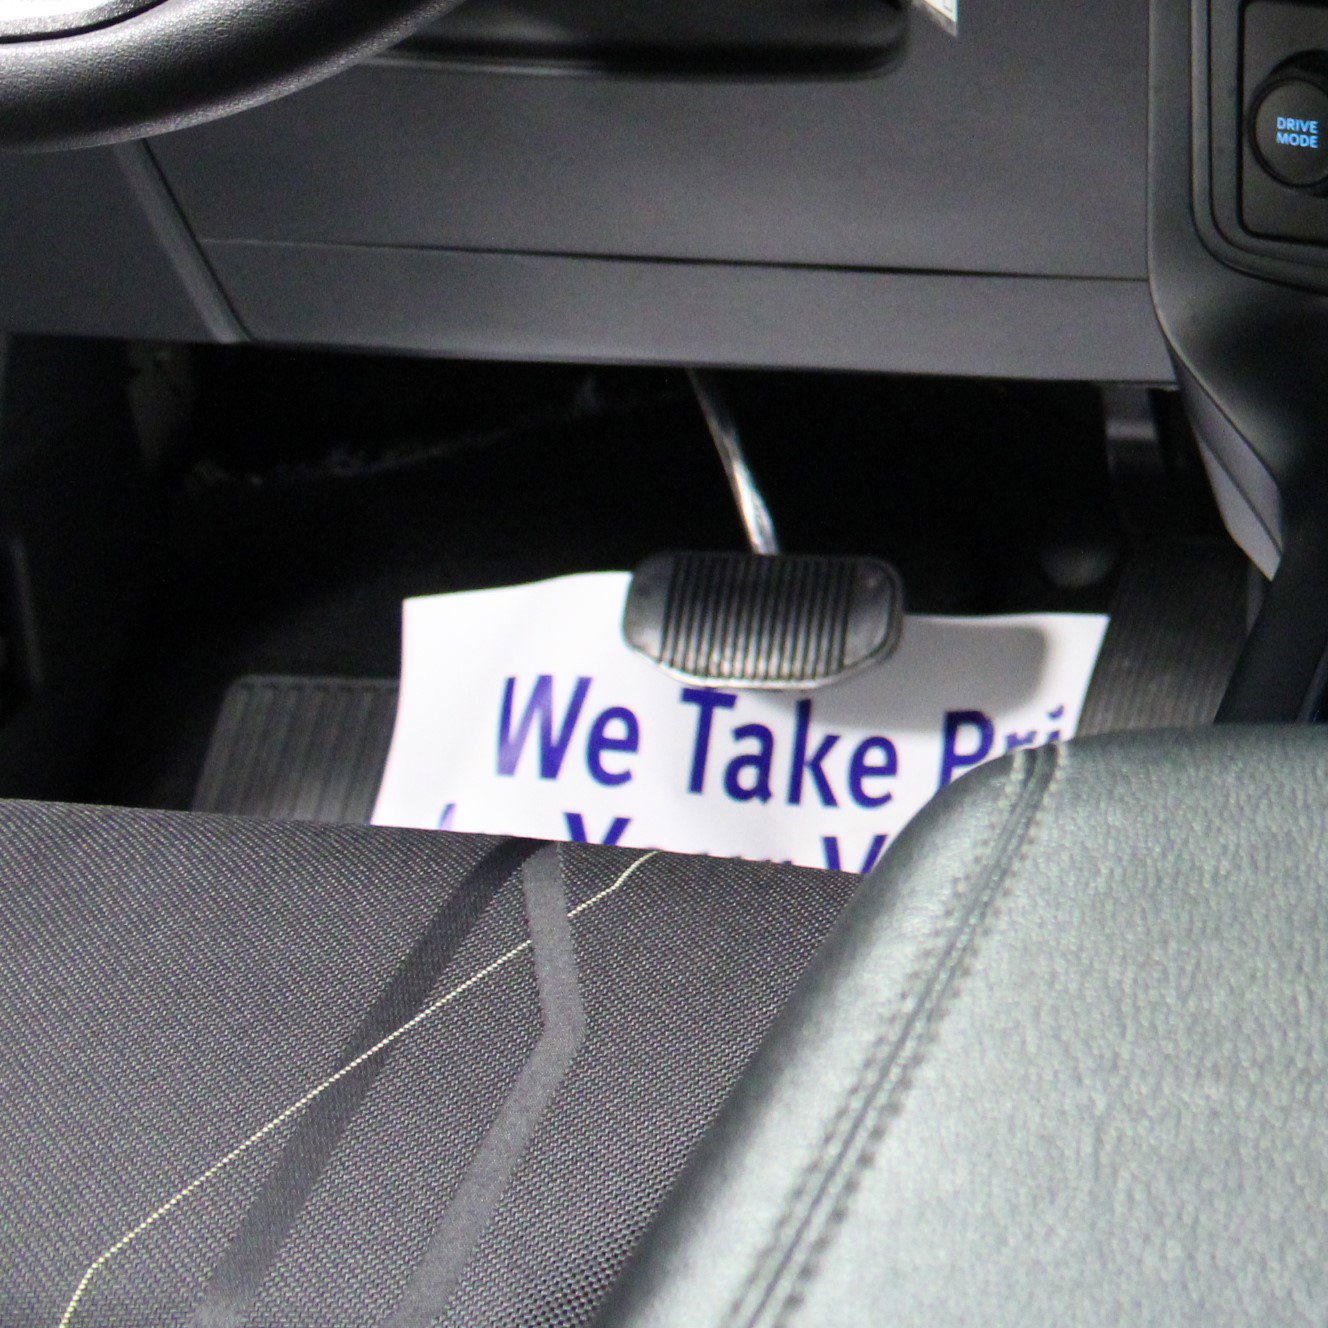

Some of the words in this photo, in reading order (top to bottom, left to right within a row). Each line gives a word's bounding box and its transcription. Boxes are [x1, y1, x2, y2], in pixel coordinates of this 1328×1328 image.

[1277, 117, 1319, 133] DRIVE
[1276, 132, 1318, 148] MODE
[496, 675, 640, 786] We
[680, 687, 899, 809] Take
